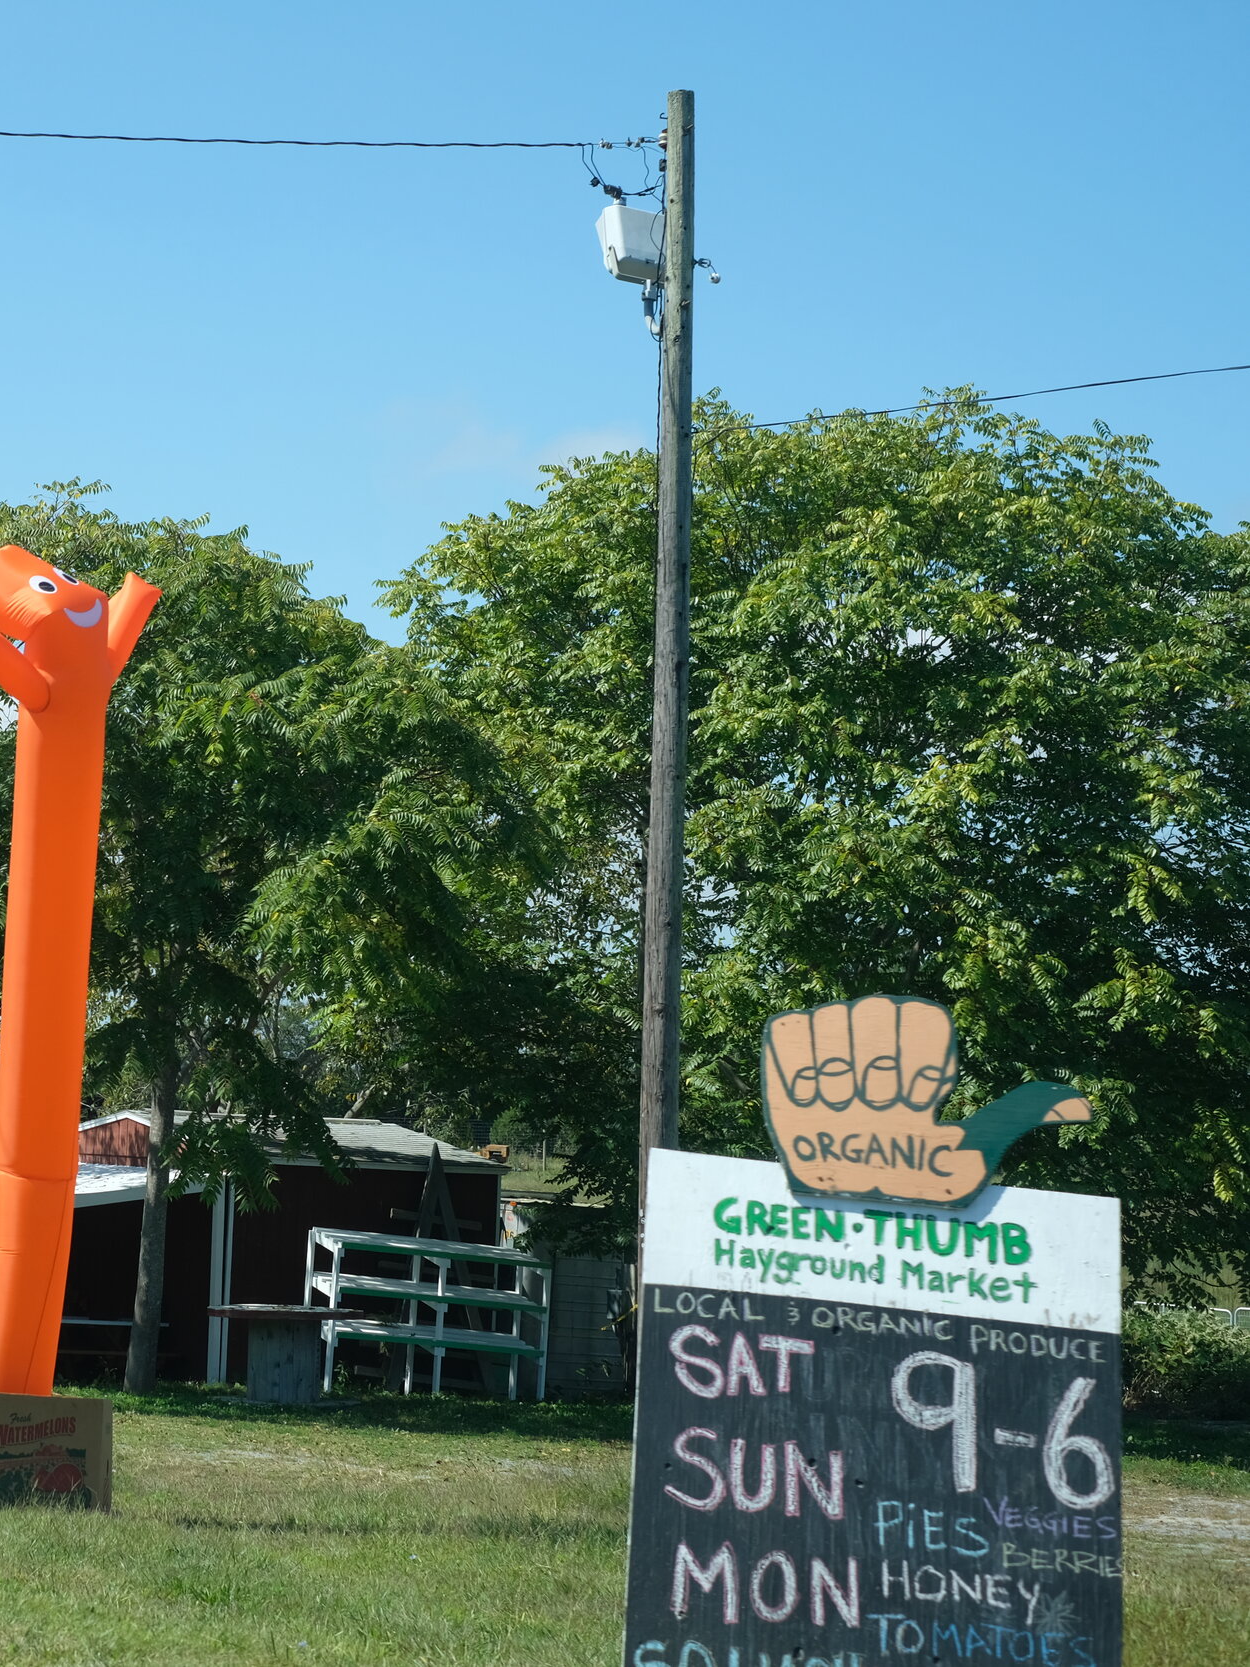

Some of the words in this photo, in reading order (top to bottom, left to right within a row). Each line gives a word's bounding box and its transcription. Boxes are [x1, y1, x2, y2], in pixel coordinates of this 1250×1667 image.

[792, 1130, 958, 1178] ORGANIC
[713, 1237, 886, 1285] Hayground
[901, 1259, 1039, 1303] Market
[653, 1287, 766, 1321] LOCAL
[811, 1306, 954, 1341] ORGANIC
[970, 1322, 1108, 1365] PRODUCE
[668, 1323, 816, 1399] SAT
[9, 1411, 32, 1424] Fresh
[891, 1349, 1116, 1511] 9-6
[664, 1426, 845, 1520] SUN
[982, 1495, 1118, 1539] VEGGIES
[670, 1540, 860, 1628] MON
[881, 1558, 1040, 1626] HONEY
[864, 1612, 1097, 1667] TOMATOES
